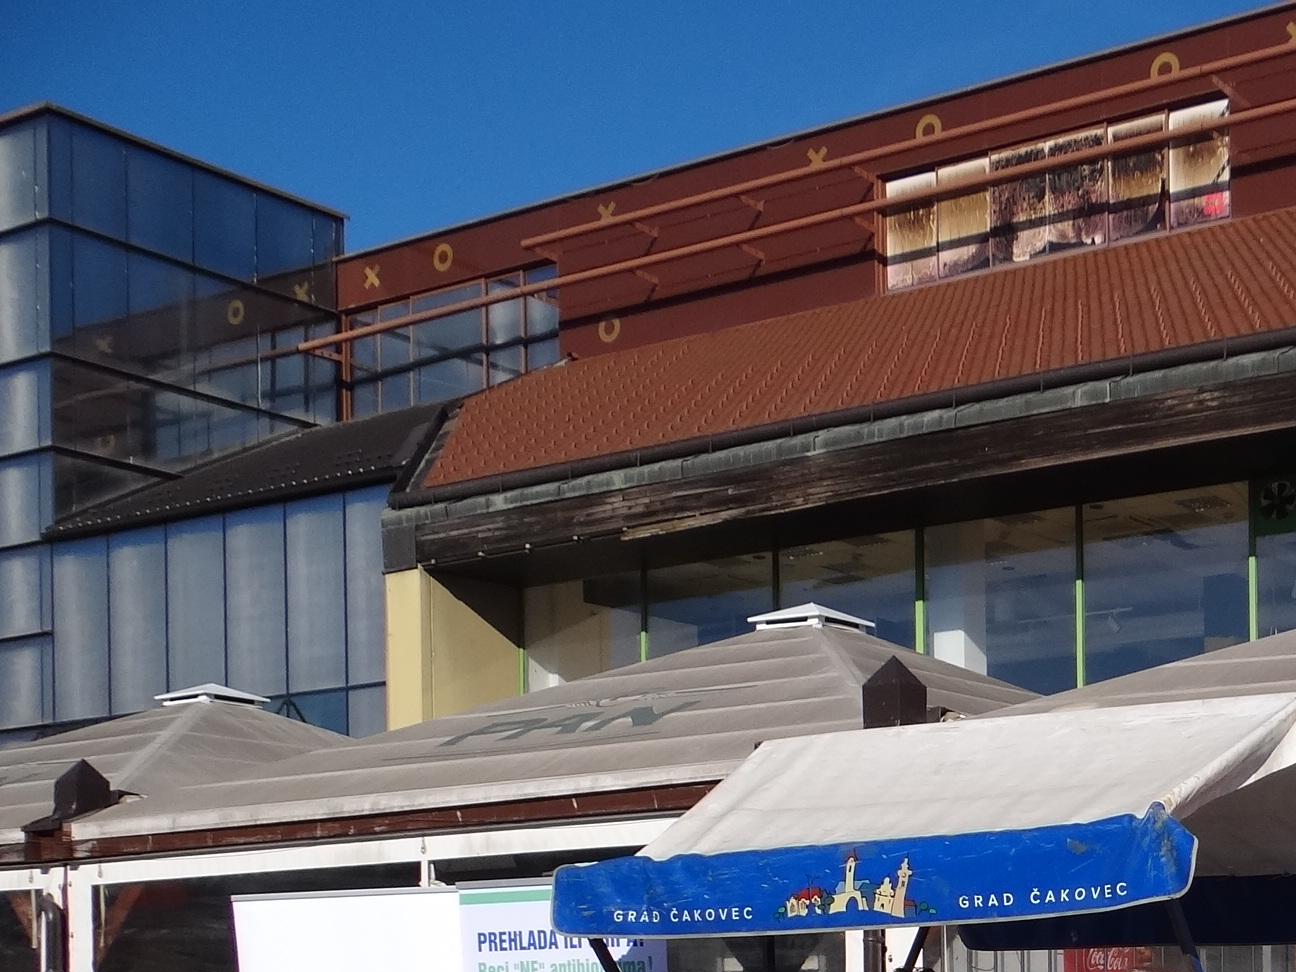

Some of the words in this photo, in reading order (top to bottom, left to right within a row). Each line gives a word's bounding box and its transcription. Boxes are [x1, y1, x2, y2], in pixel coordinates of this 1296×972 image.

[437, 699, 703, 747] PAN
[959, 892, 1014, 908] GRAD
[1030, 882, 1127, 904] ČAKOVEC
[613, 910, 660, 922] GRAD
[670, 906, 753, 922] ČAKOVEC
[477, 929, 559, 952] PREHLADA
